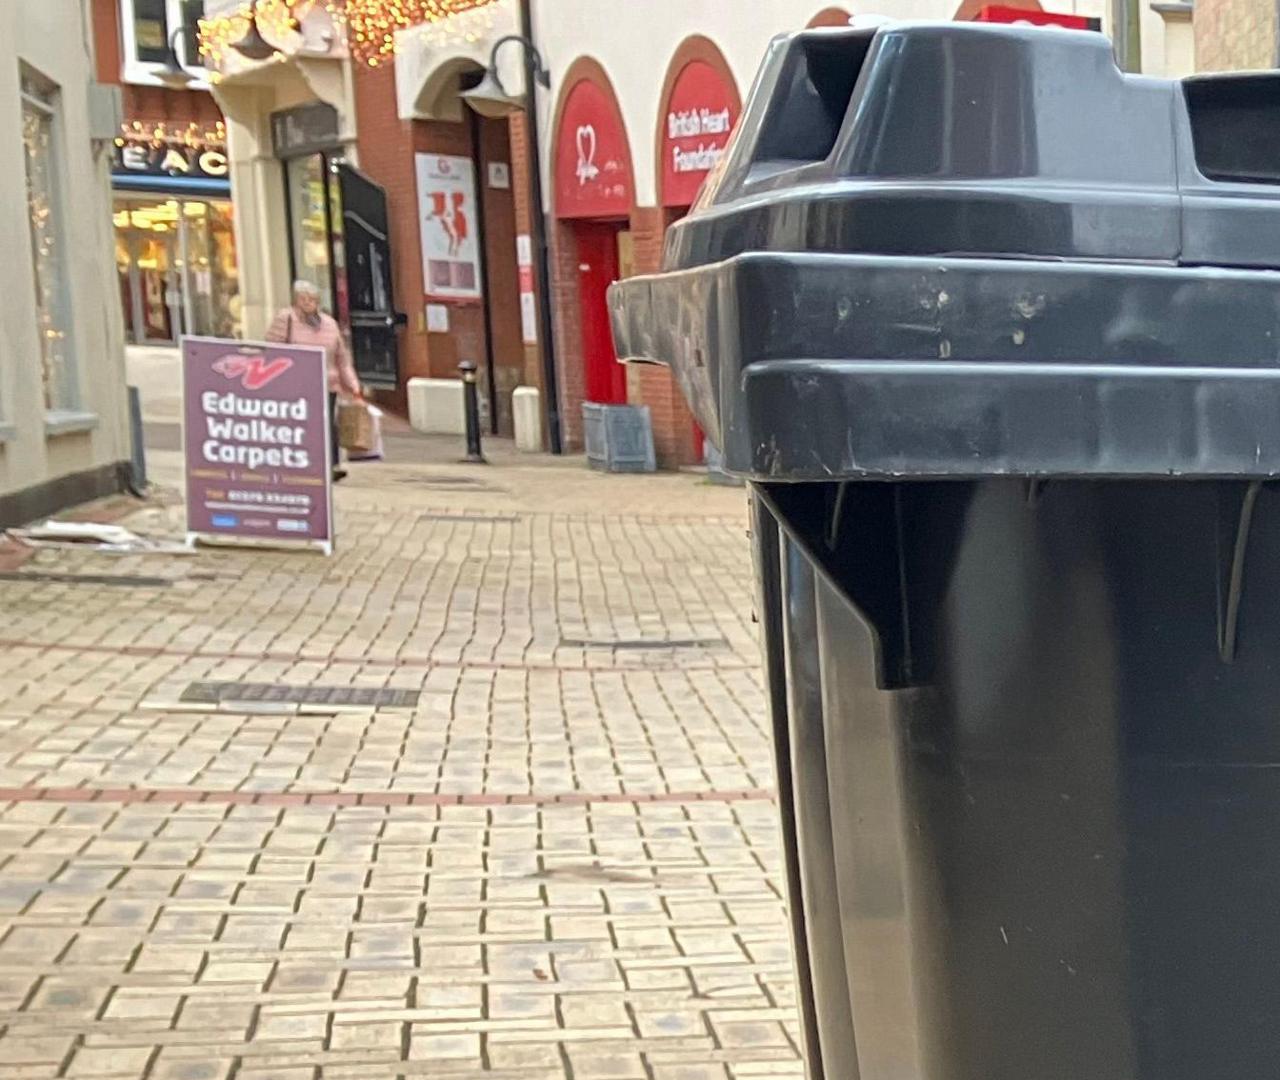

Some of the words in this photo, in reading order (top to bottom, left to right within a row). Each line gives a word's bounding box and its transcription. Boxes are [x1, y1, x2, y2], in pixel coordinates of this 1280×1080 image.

[668, 108, 700, 138] British
[700, 107, 730, 133] Heart
[202, 391, 307, 420] Edward
[206, 416, 305, 445] Walker
[202, 440, 309, 469] Carpets
